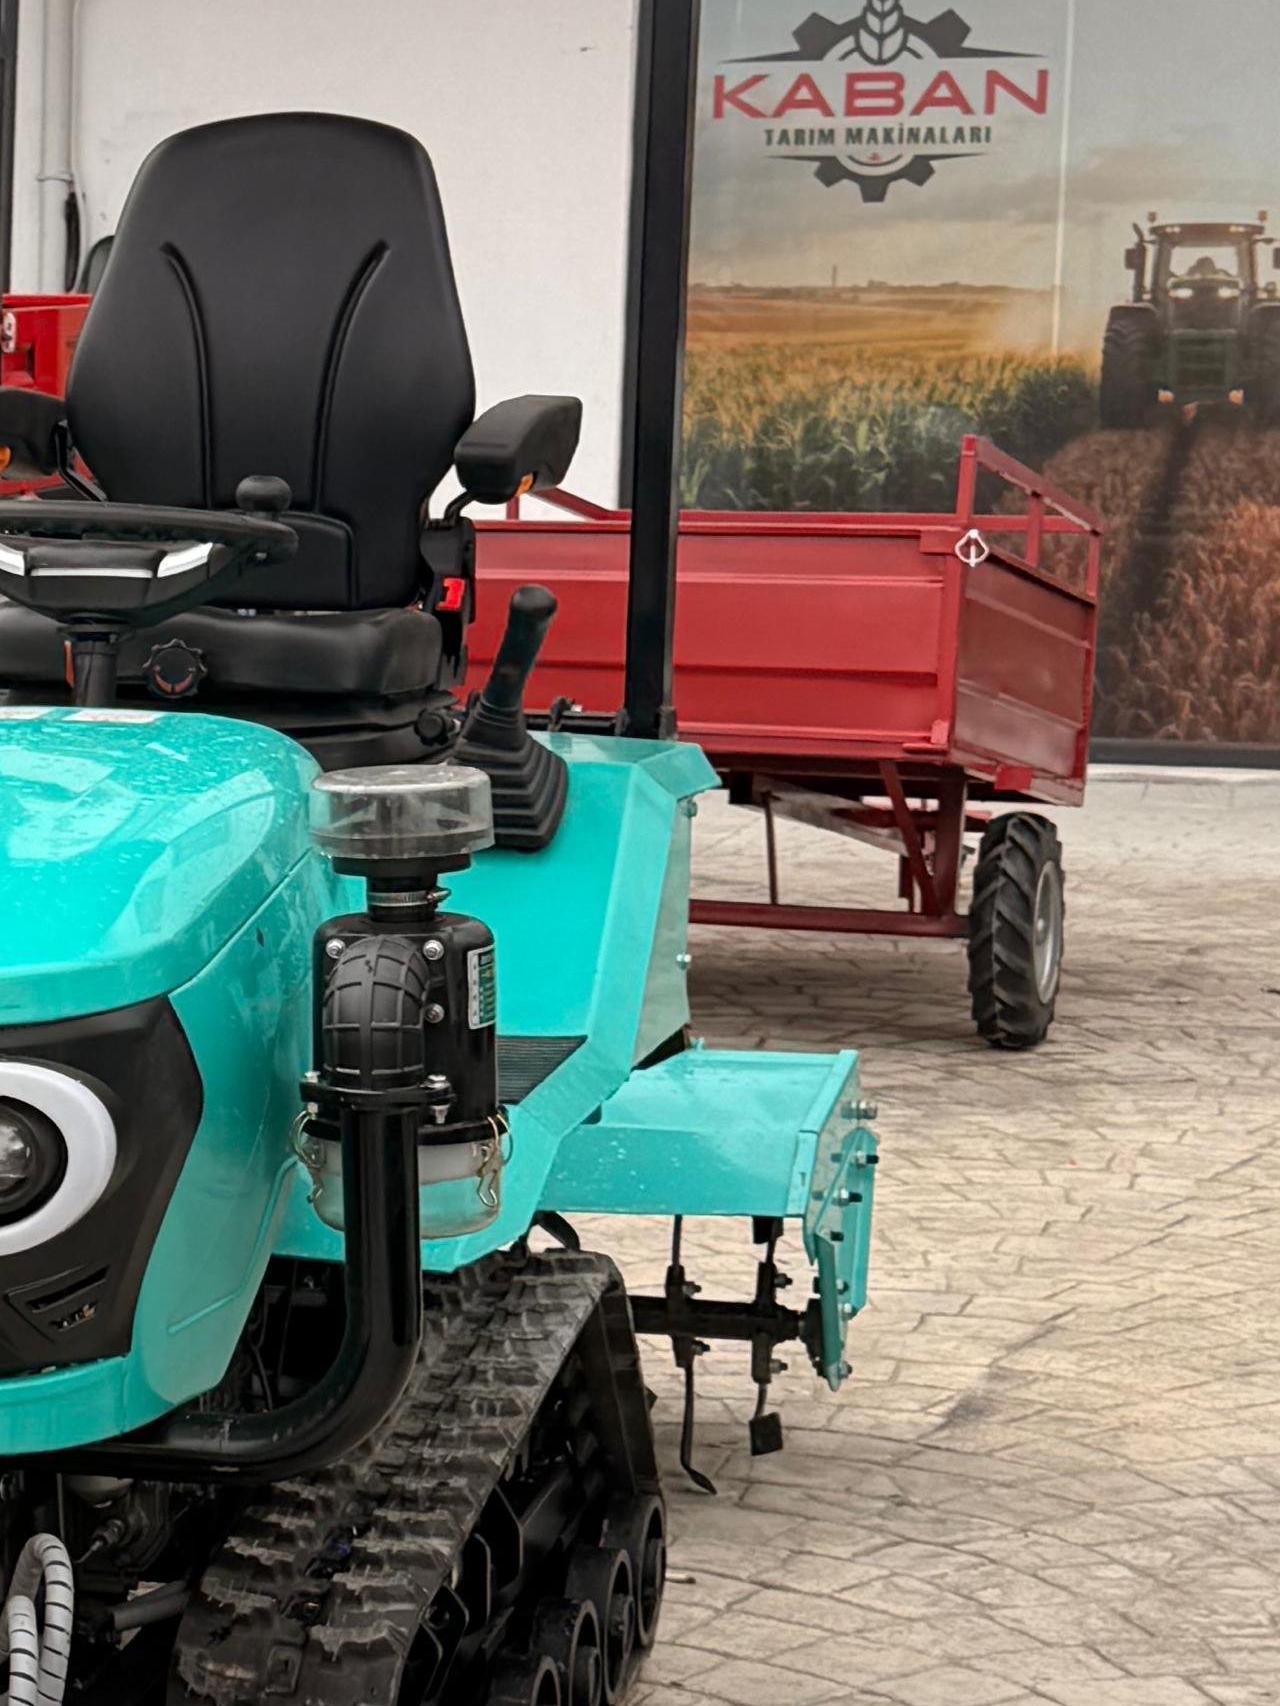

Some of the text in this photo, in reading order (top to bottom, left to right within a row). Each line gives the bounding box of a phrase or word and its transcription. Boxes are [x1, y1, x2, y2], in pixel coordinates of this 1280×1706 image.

[713, 68, 1049, 120] KABAN
[764, 122, 992, 147] TARIM MAKİNALARI
